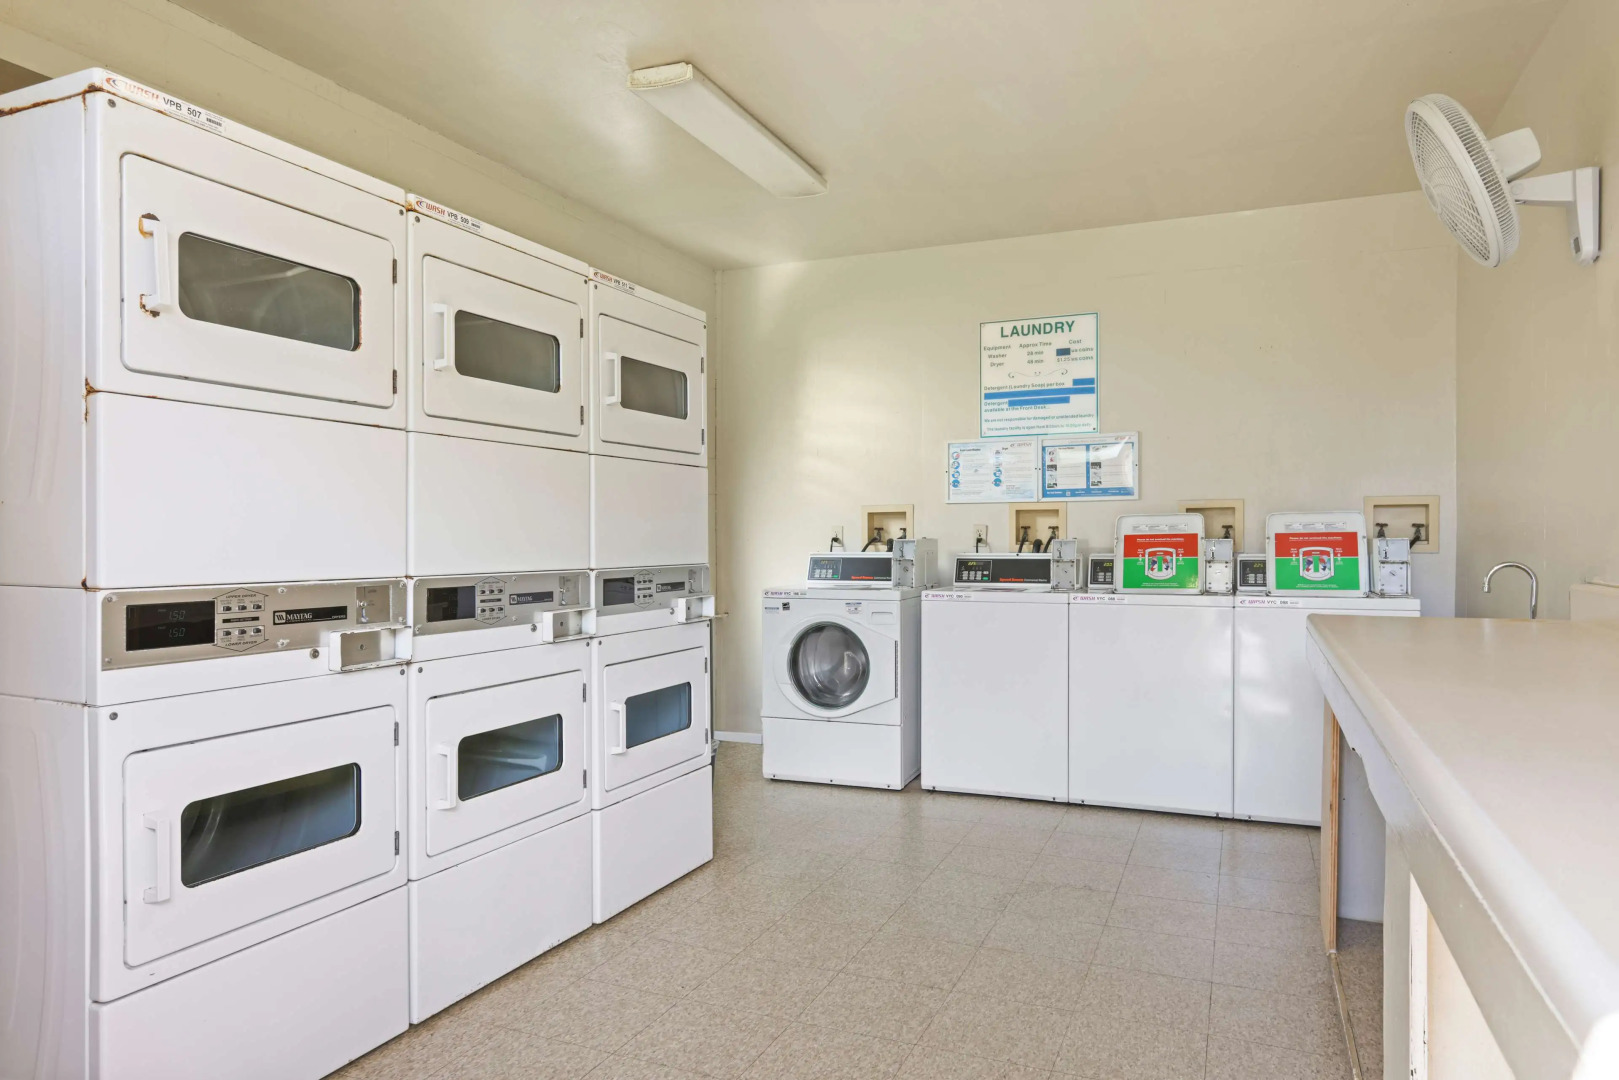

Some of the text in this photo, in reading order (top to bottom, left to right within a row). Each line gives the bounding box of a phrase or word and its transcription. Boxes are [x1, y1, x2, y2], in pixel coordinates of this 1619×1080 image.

[163, 96, 182, 112] VPB
[187, 107, 202, 119] 507
[426, 202, 446, 216] WASH
[447, 210, 458, 220] VPB
[1000, 320, 1075, 338] LAUNDRY
